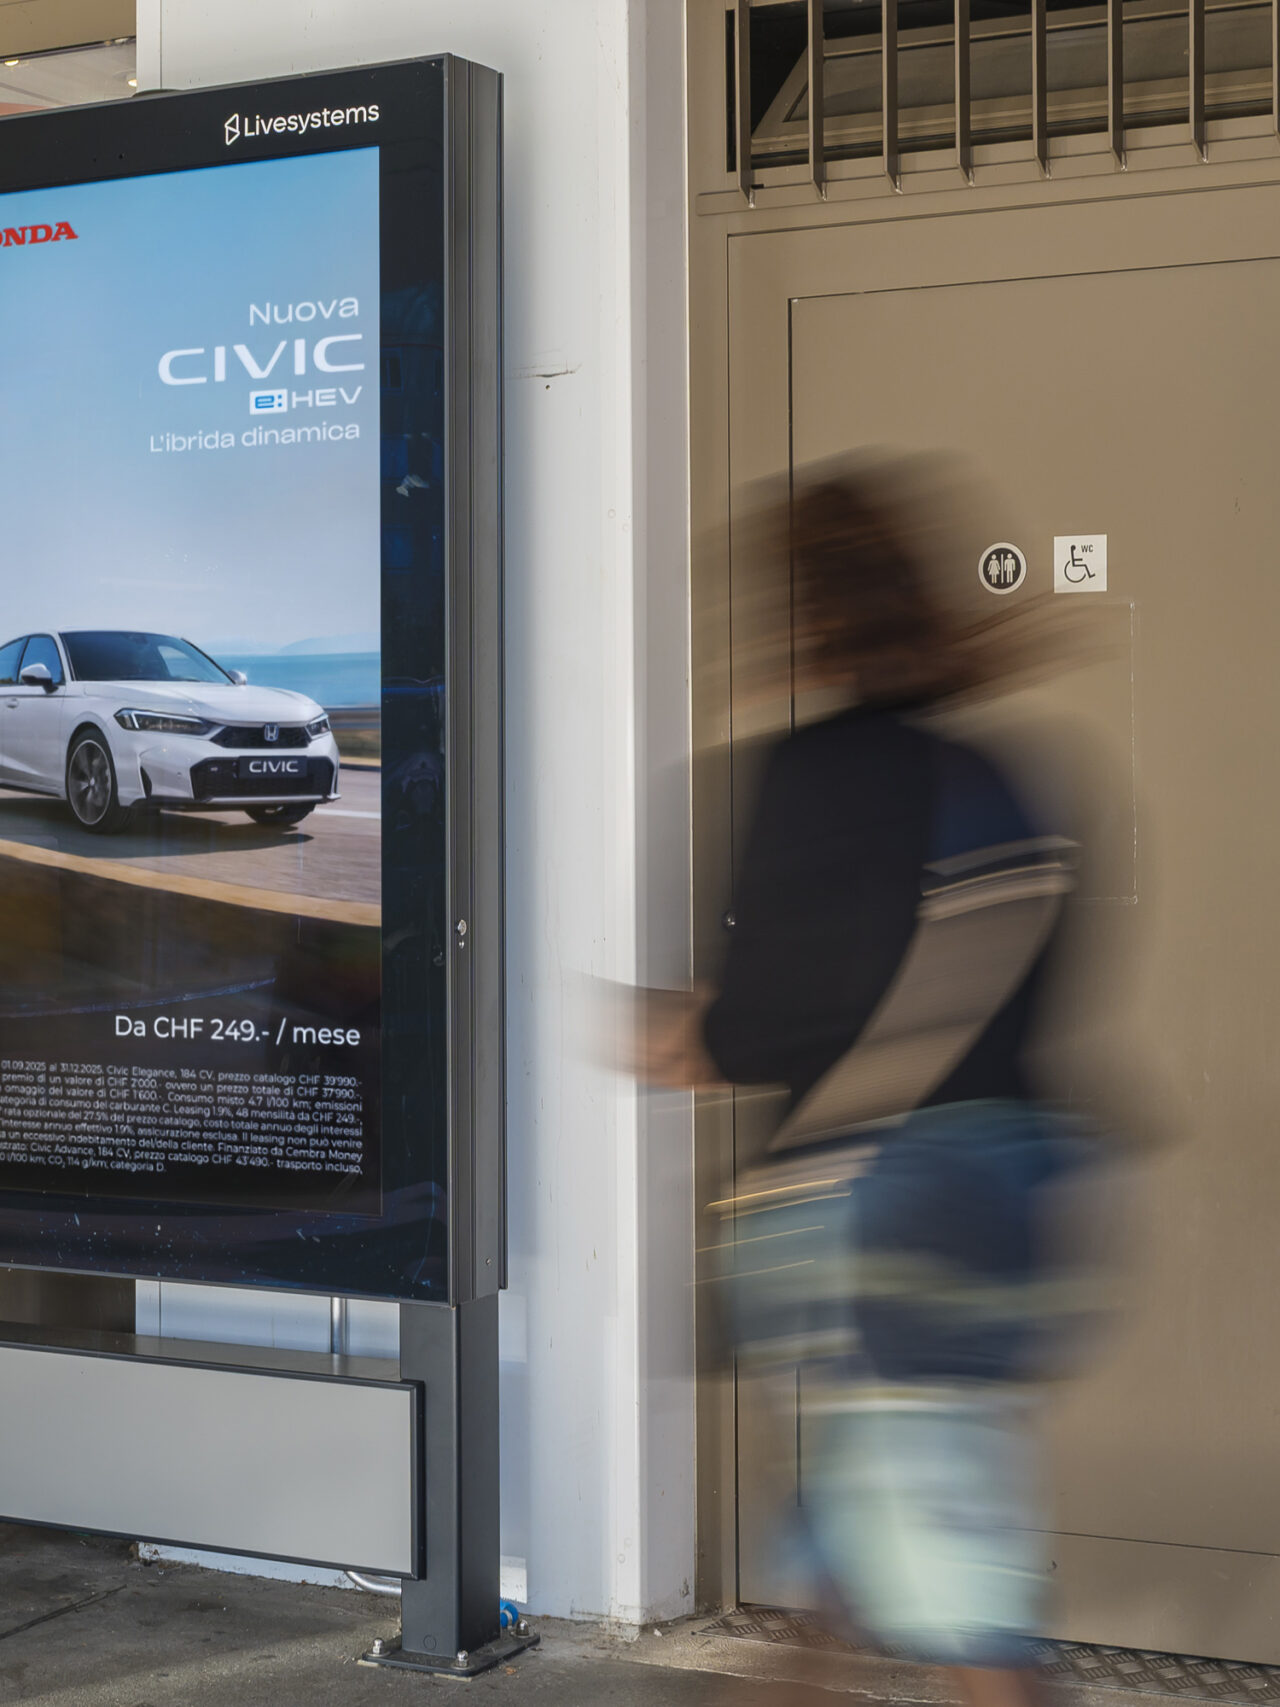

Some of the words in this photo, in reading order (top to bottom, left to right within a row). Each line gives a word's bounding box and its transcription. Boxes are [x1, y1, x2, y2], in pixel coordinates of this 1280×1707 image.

[244, 104, 380, 138] Livesystems
[250, 297, 360, 326] Nuova
[158, 333, 366, 386] CIVIC
[150, 430, 235, 453] L'ibrida
[241, 421, 360, 447] dinamica
[1081, 545, 1094, 553] WC
[249, 760, 299, 773] CIVIC
[115, 1015, 146, 1037] Da
[153, 1016, 204, 1039] CHF
[210, 1018, 270, 1042] 249.-
[275, 1017, 287, 1046] /
[293, 1026, 361, 1046] mese
